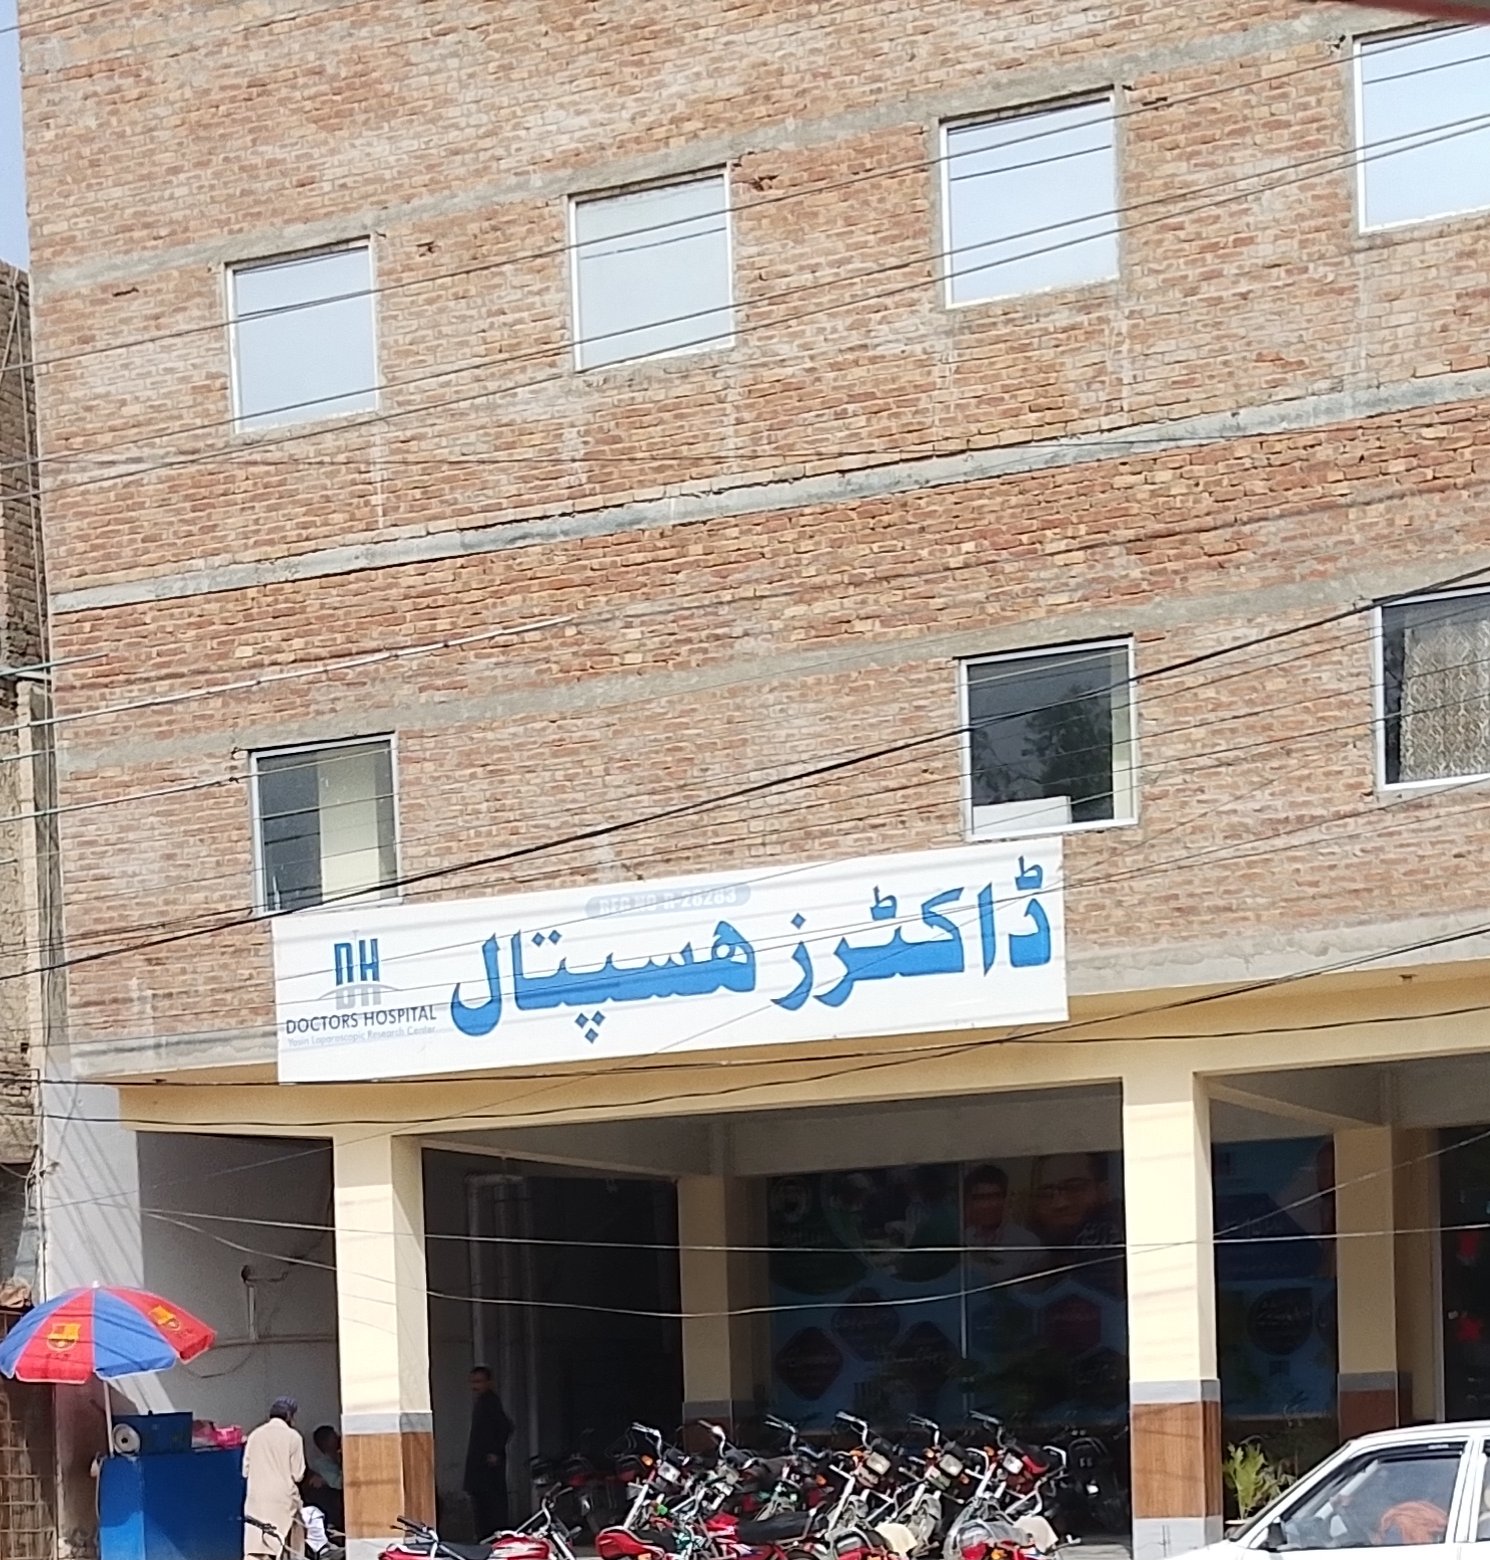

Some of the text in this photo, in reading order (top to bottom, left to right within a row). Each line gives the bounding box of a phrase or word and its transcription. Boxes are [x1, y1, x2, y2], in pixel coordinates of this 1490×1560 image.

[770, 855, 1051, 1011] ڈاکٹرز
[286, 1004, 437, 1035] DOCTORS HOSPITAL
[367, 1028, 405, 1039] Research
